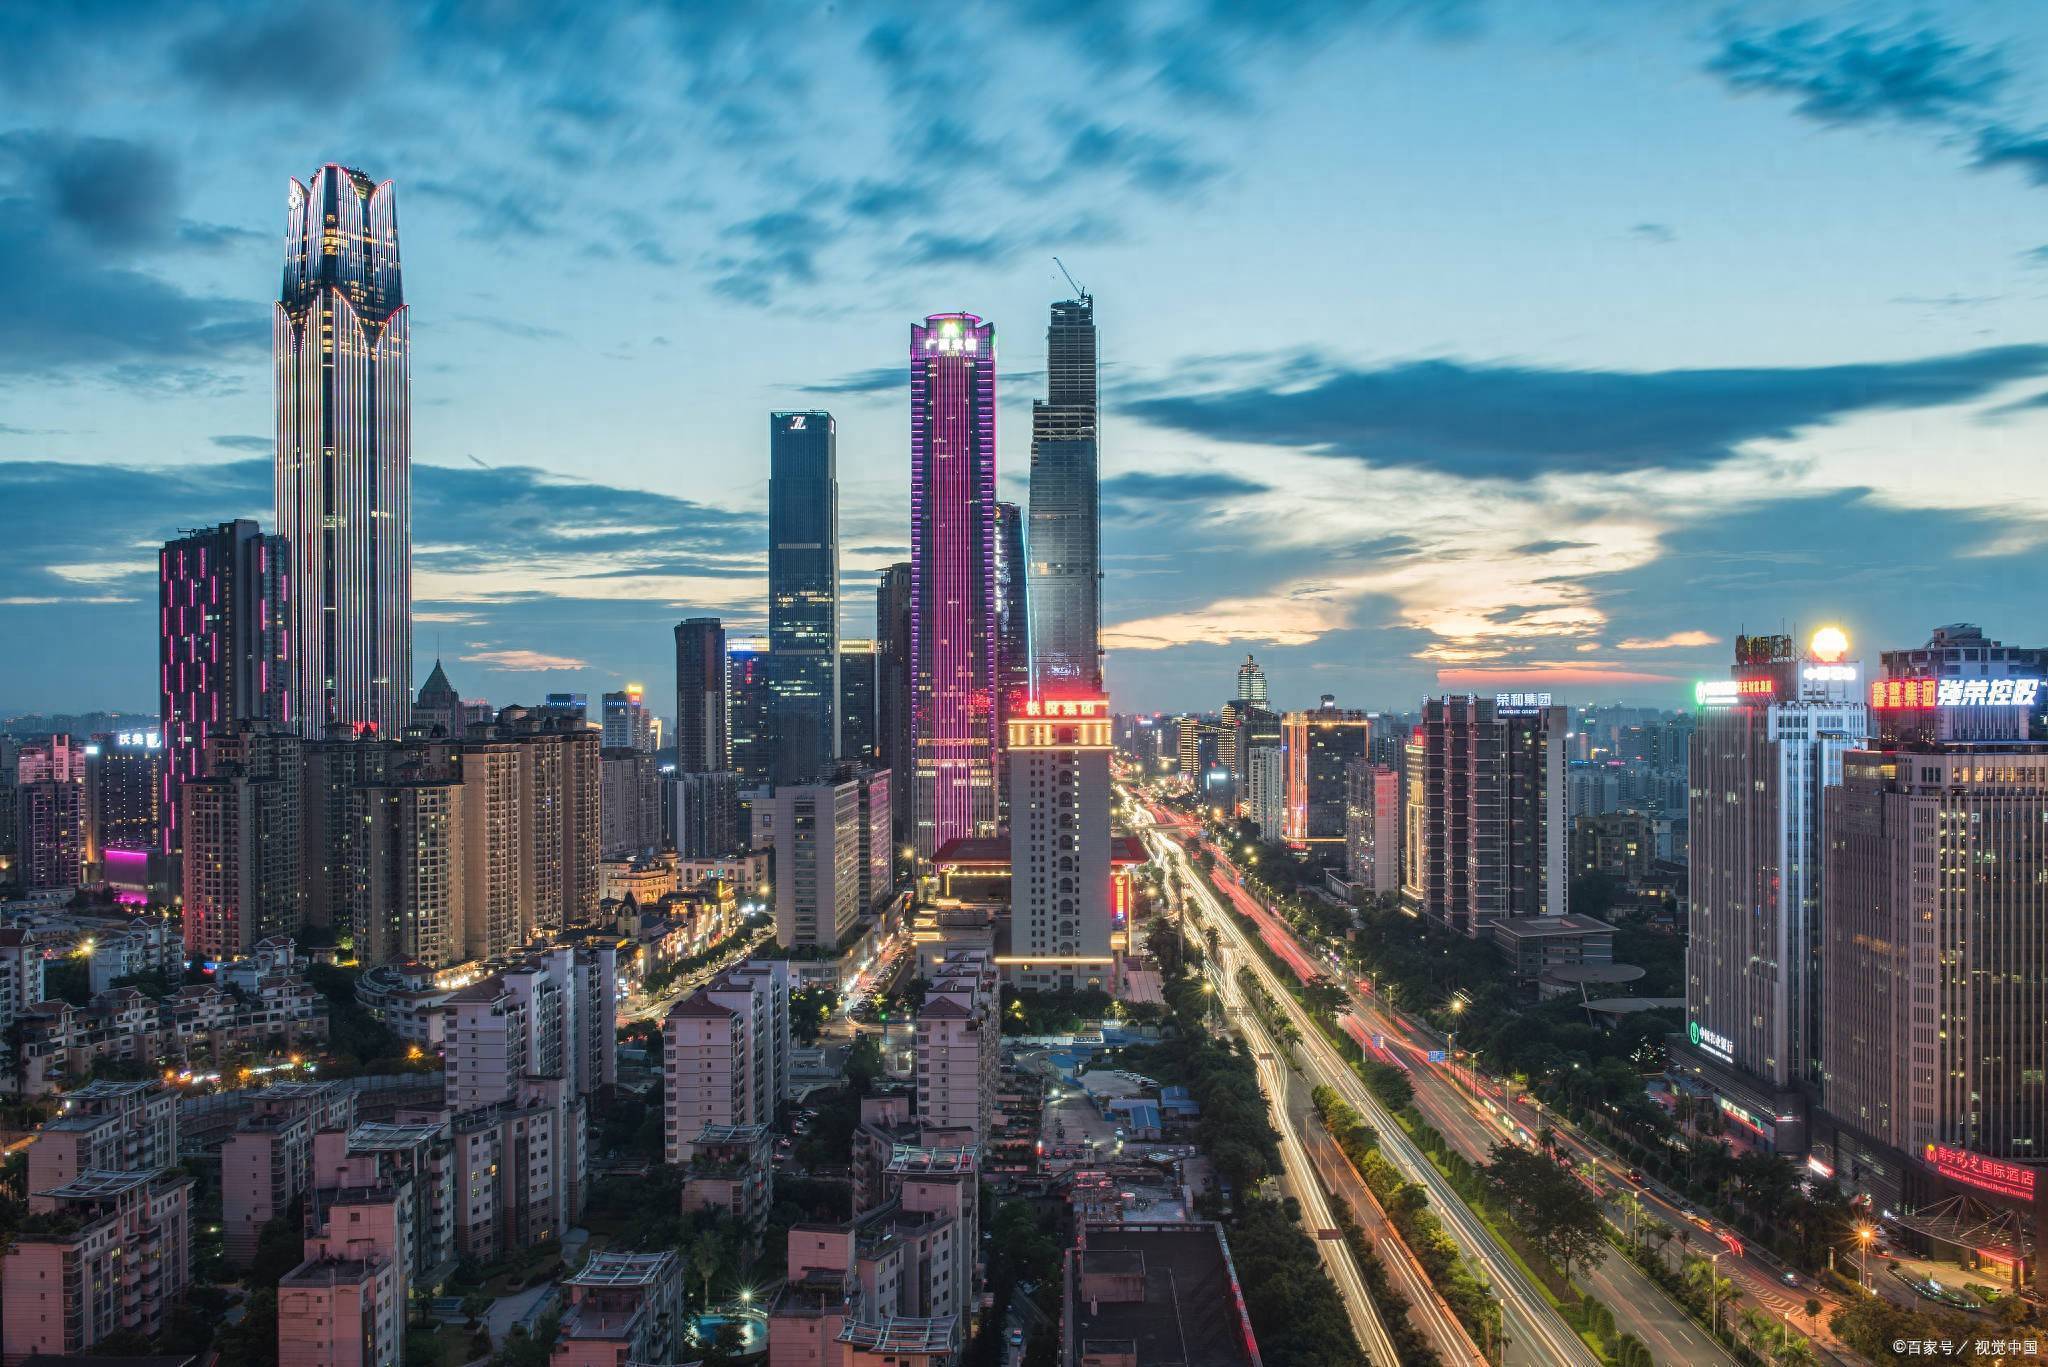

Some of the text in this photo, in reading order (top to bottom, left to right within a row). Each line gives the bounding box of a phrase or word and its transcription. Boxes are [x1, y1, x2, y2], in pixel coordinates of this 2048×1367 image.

[1496, 692, 1551, 707] 荣和集团
[1699, 1026, 1733, 1054] 中国农业银行
